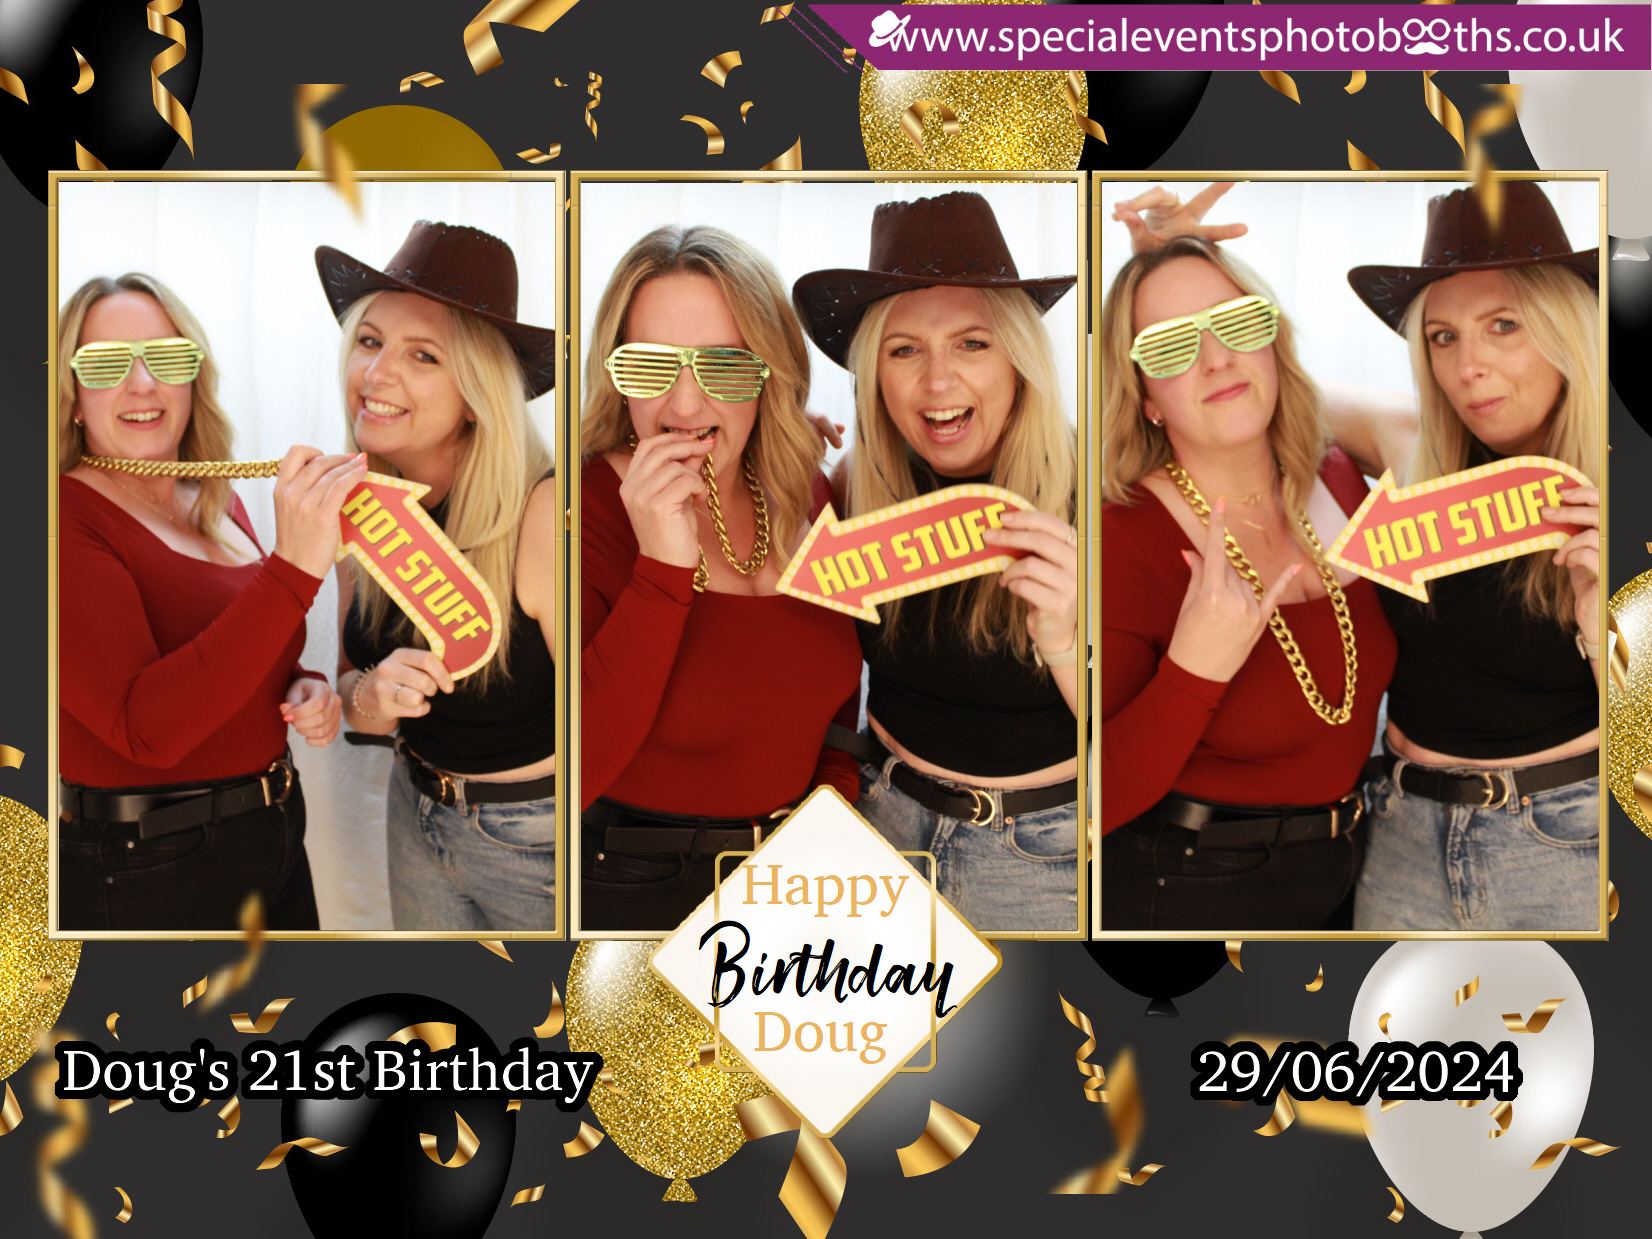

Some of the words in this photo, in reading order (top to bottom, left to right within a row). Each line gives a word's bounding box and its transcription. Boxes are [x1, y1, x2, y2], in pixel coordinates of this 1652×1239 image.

[341, 487, 414, 559] HOT
[395, 549, 491, 642] STUFF
[810, 541, 890, 597] HOT
[1363, 510, 1443, 570] HOT
